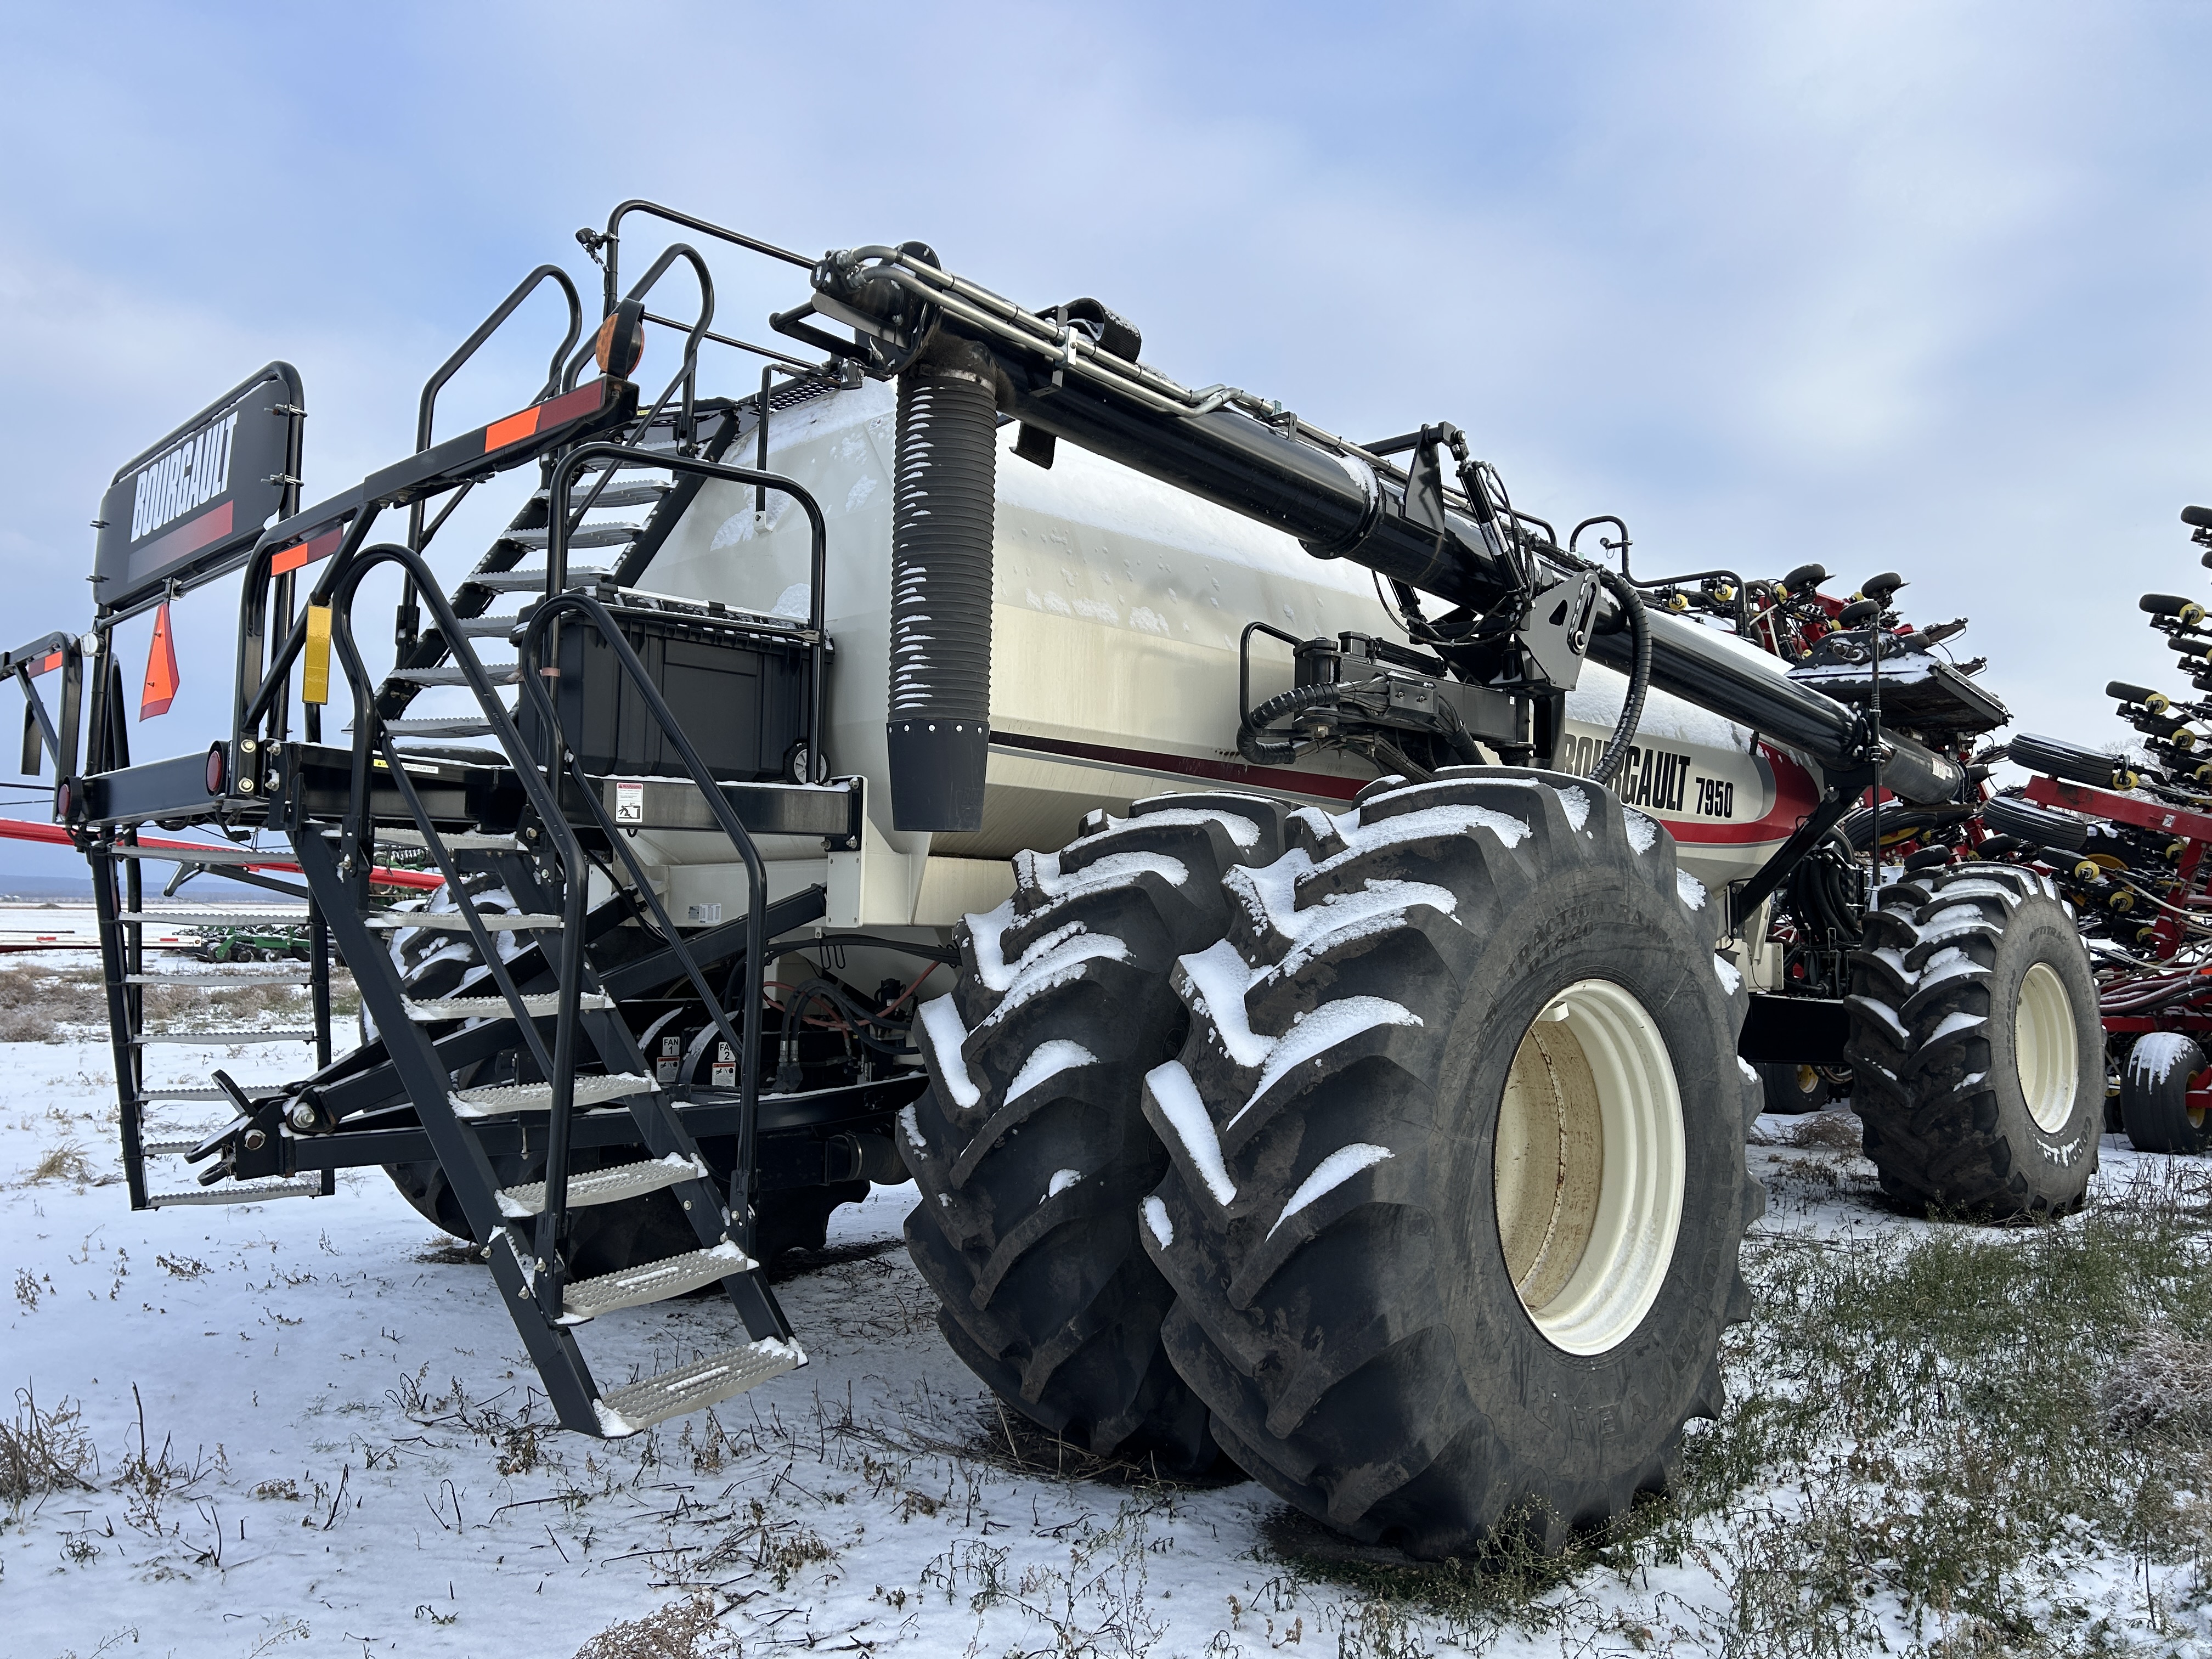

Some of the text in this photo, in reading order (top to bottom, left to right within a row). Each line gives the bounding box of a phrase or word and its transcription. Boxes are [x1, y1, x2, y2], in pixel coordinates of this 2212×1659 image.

[131, 410, 239, 543] BOURGAULT
[1696, 777, 1734, 819] 7950
[669, 1046, 673, 1054] 1
[724, 1051, 730, 1060] 2
